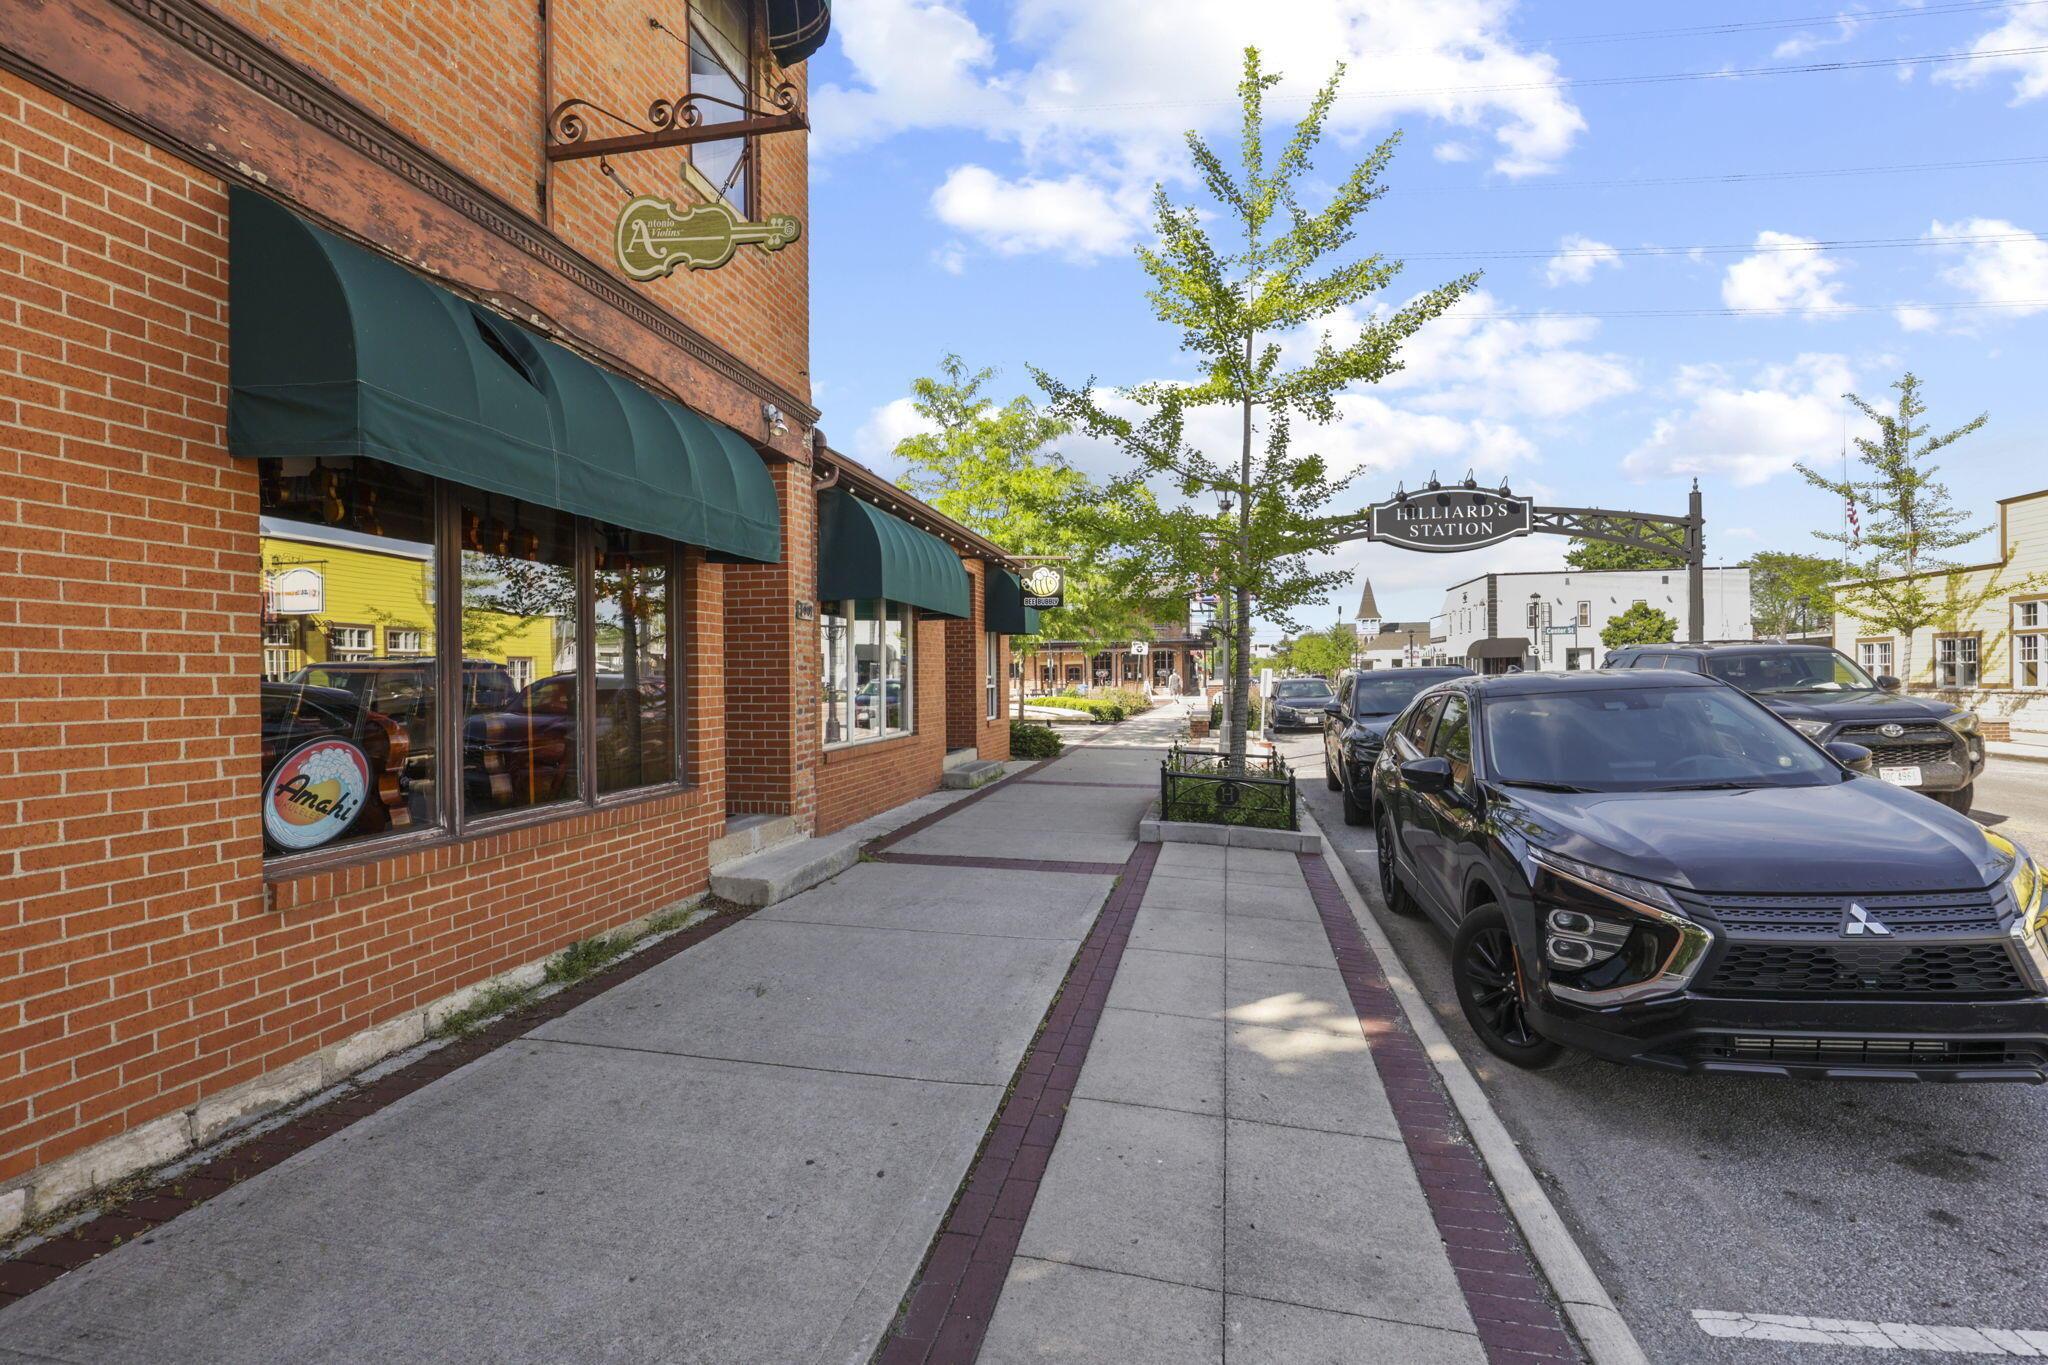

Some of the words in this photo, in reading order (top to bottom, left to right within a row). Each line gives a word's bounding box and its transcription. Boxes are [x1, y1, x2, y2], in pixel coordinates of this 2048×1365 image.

[625, 218, 675, 258] Antonio
[1396, 502, 1508, 521] HILLIARD'S
[1409, 521, 1493, 537] STATION
[1024, 597, 1036, 606] BEE
[275, 774, 359, 821] Amahi
[1220, 786, 1234, 801] H
